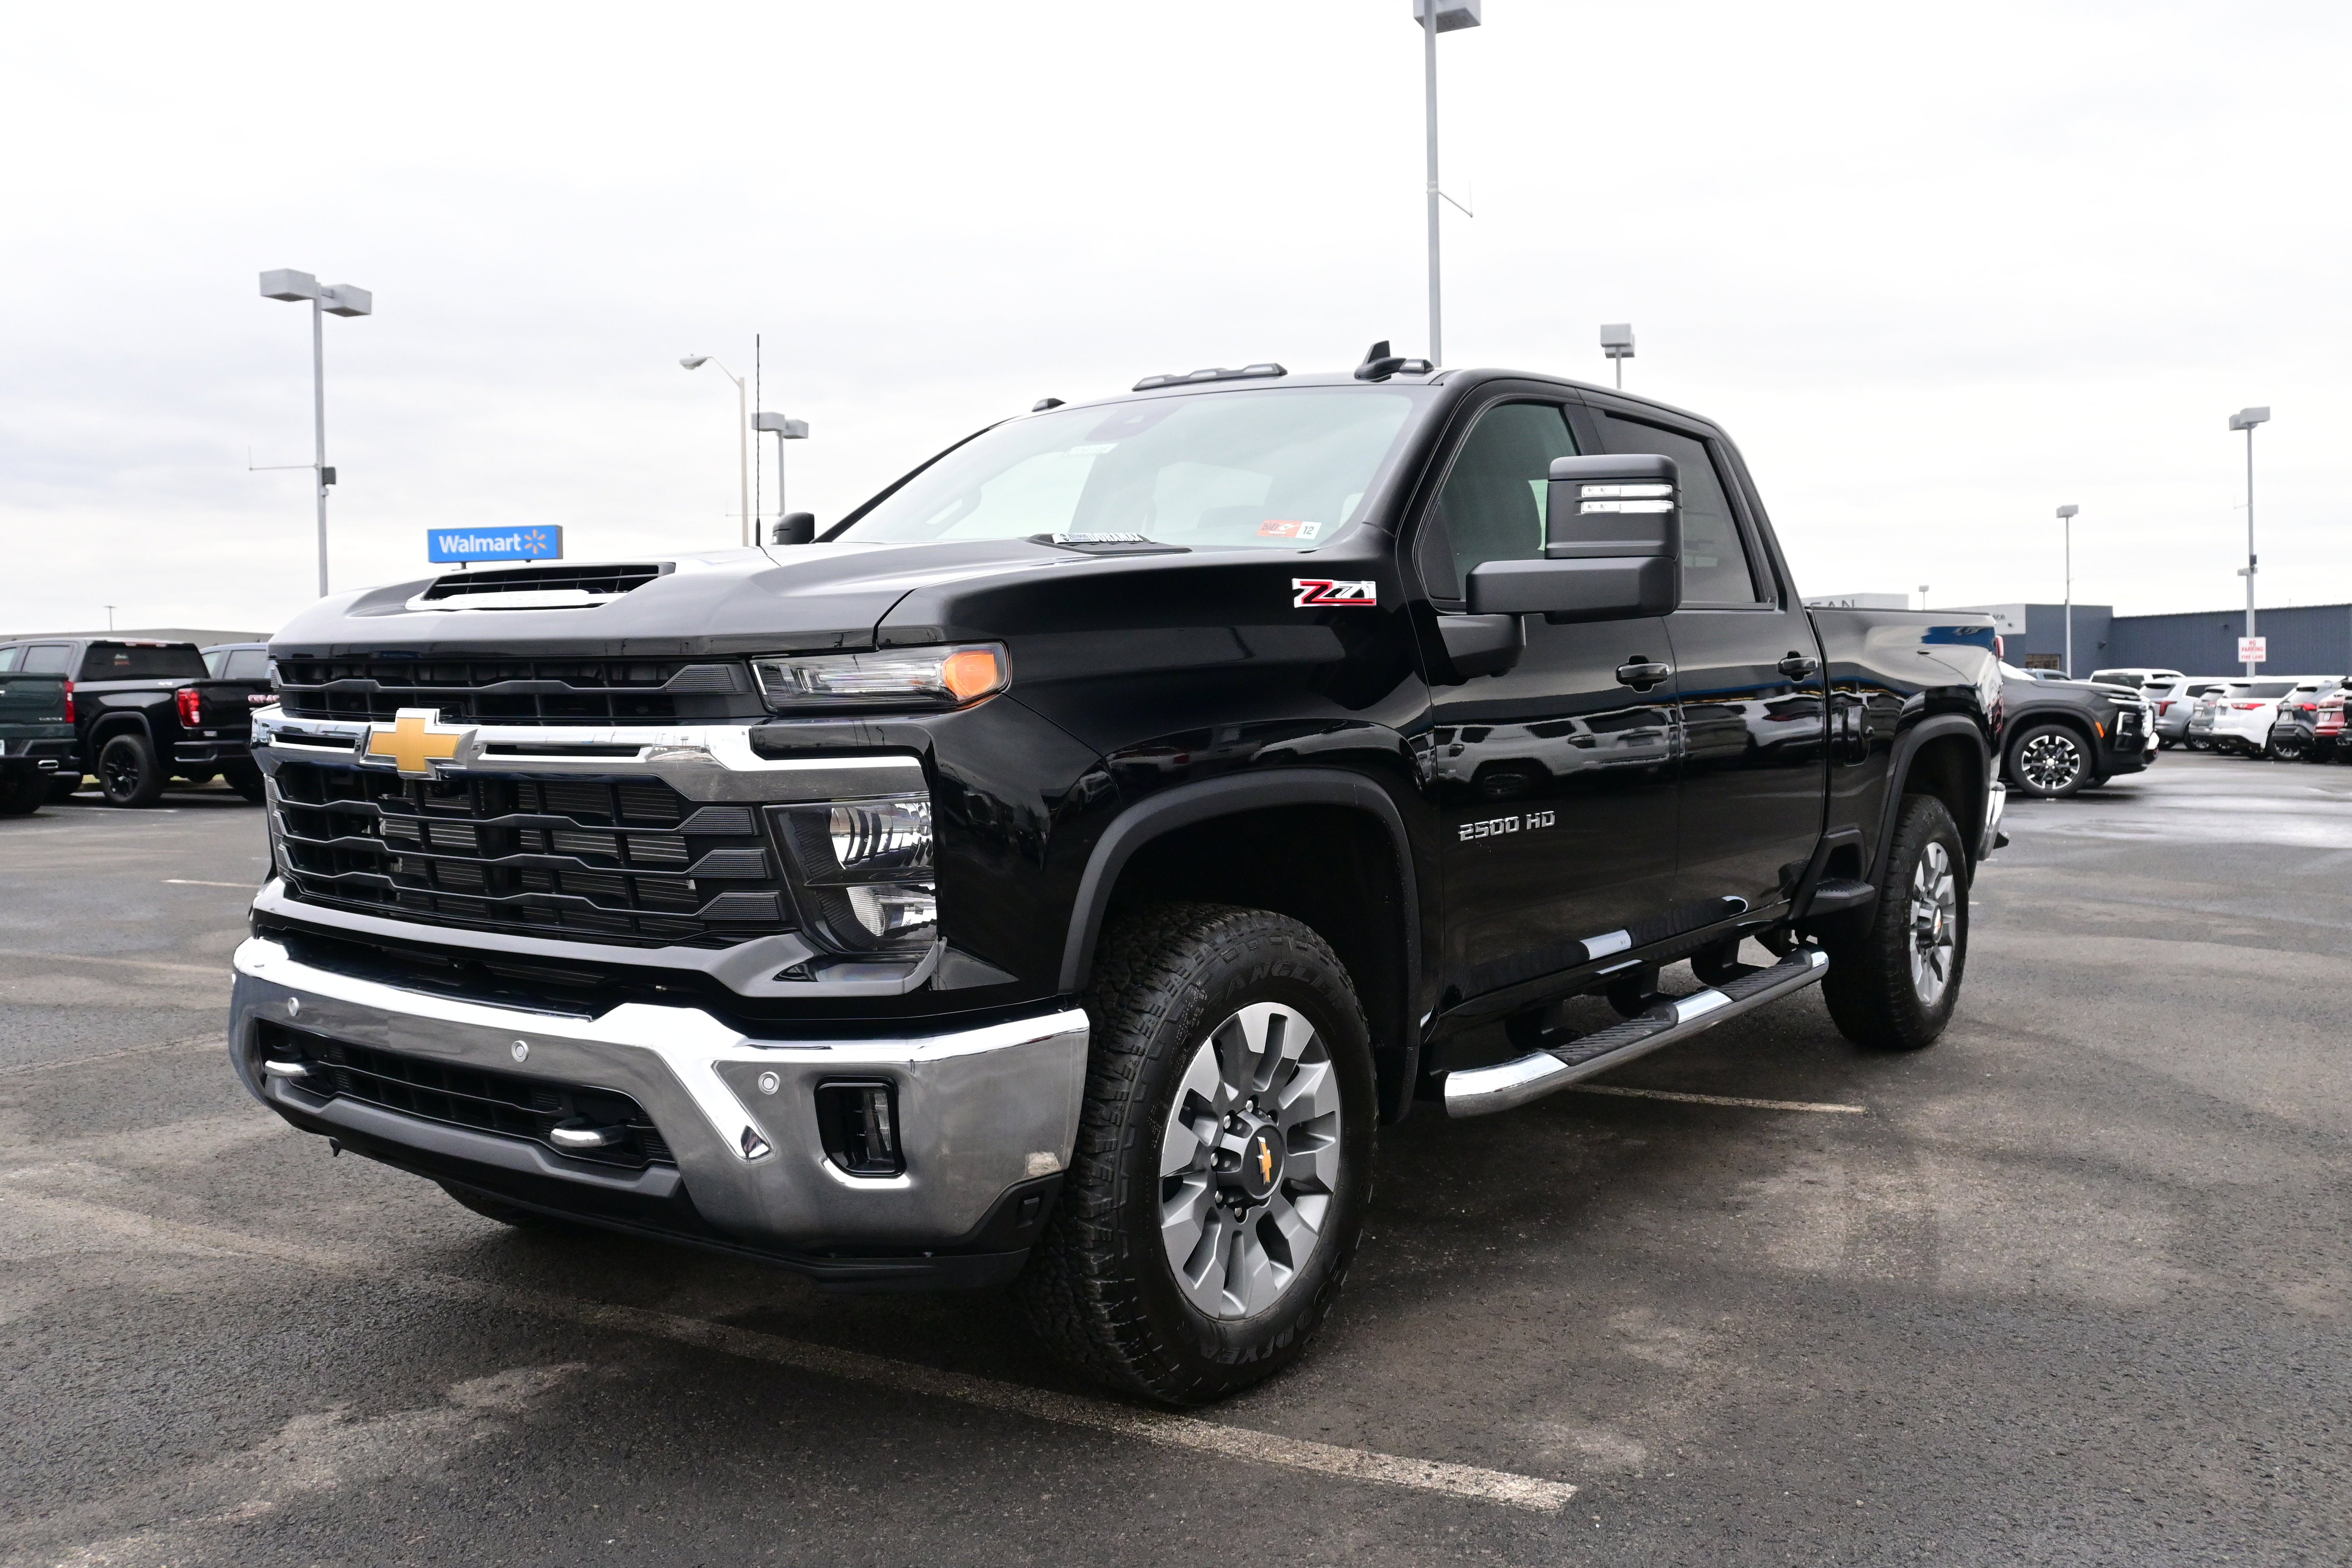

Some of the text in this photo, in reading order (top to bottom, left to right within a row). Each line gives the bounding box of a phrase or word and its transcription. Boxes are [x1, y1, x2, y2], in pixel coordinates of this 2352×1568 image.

[1303, 526, 1314, 535] 12
[438, 533, 521, 553] Walmart
[1292, 578, 1376, 608] Z71
[248, 694, 280, 703] GMC
[1458, 811, 1555, 841] 2500 HD
